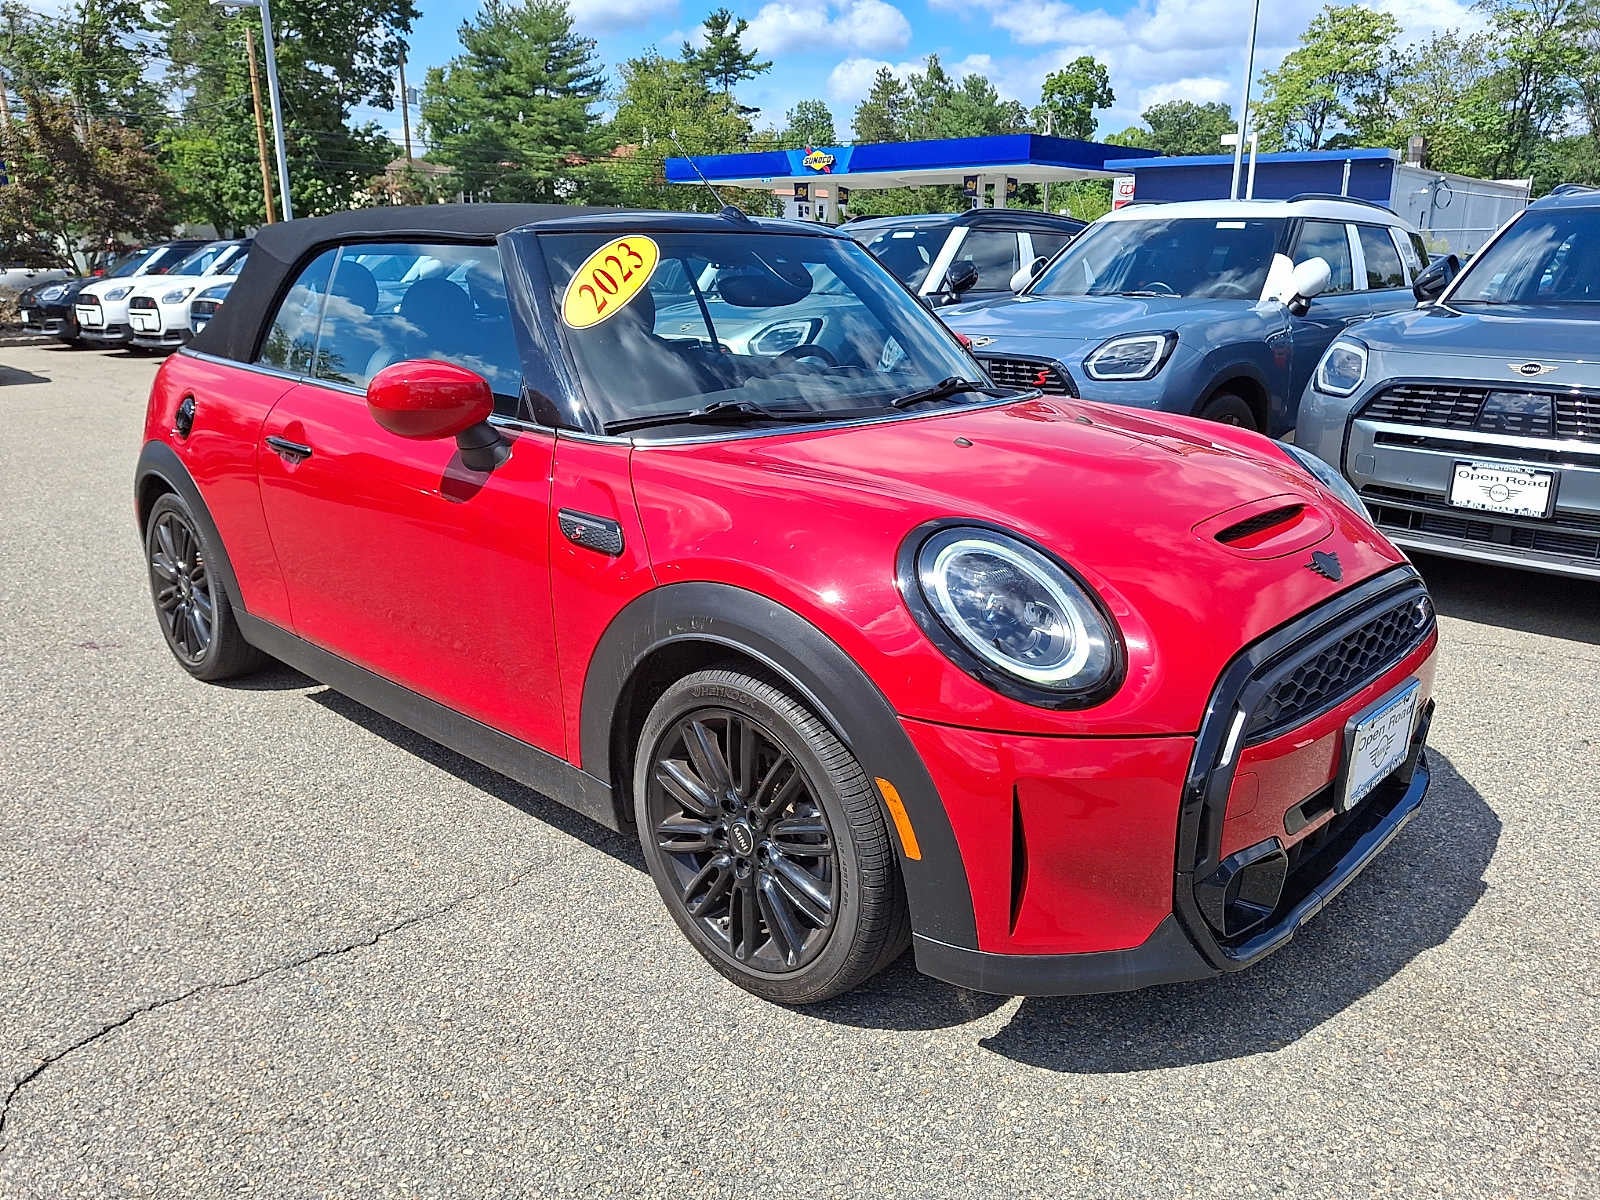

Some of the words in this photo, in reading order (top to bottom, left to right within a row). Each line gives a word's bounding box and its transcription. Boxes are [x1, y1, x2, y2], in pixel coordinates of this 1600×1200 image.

[804, 156, 832, 165] SUNOCO
[579, 243, 643, 313] 2023
[1032, 370, 1051, 387] S
[1459, 470, 1499, 482] Open
[1506, 476, 1548, 488] Road
[571, 525, 585, 539] S
[1359, 725, 1386, 752] Open
[1388, 703, 1413, 730] Road
[733, 827, 749, 850] MINI
